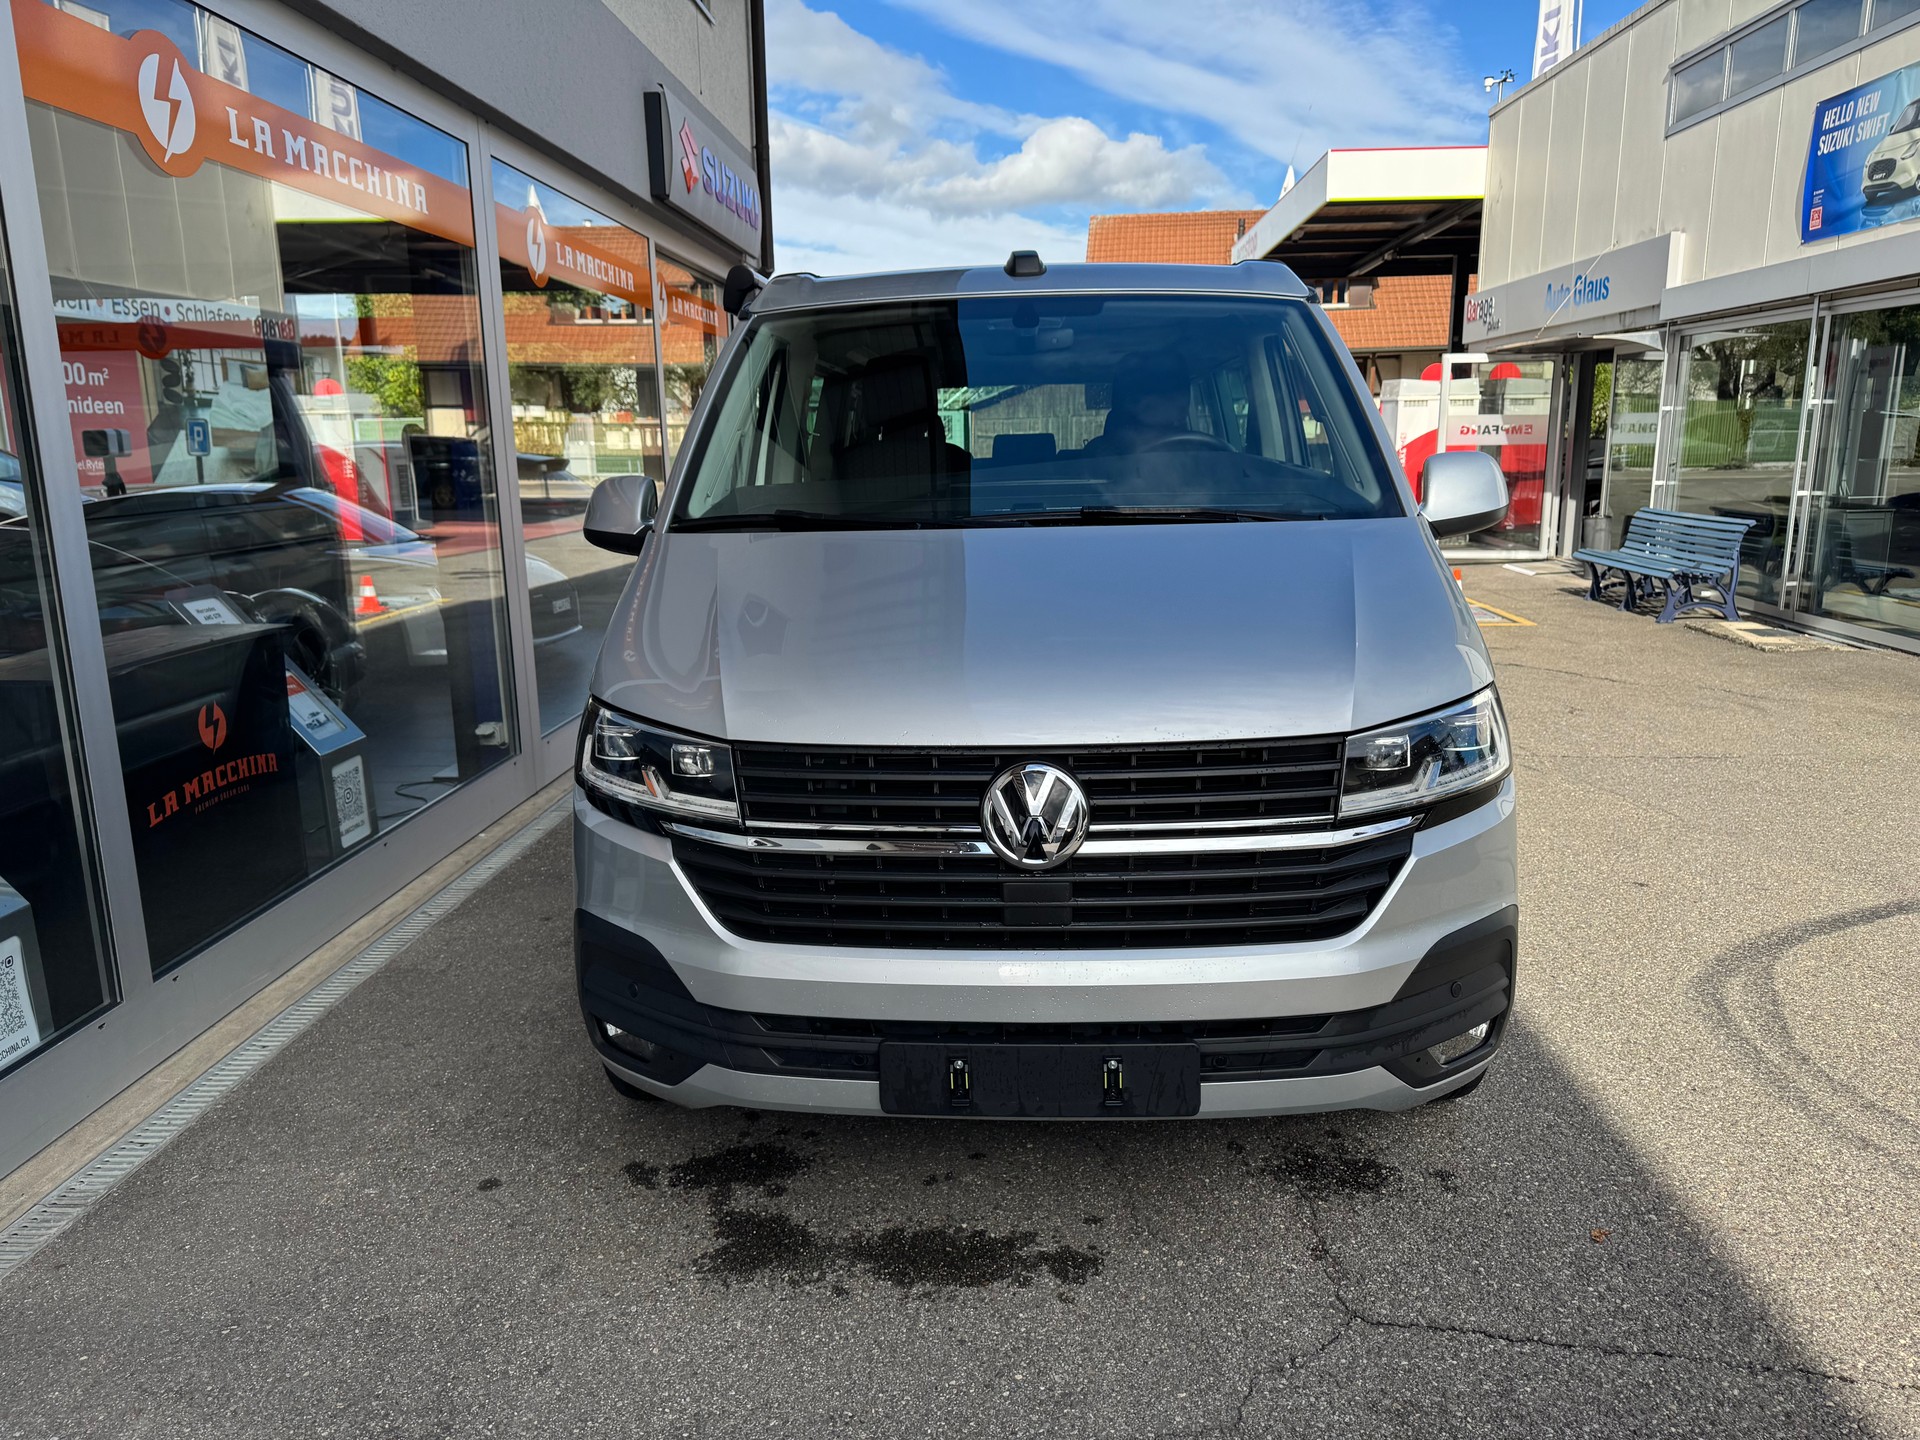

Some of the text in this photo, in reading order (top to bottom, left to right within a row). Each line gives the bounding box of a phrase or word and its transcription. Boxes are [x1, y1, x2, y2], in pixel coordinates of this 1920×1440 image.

[1822, 90, 1882, 131] HELLO NEW
[1817, 112, 1891, 156] SUZUKI SWIFT
[225, 106, 428, 215] LA MACCHINA
[702, 146, 759, 230] SUZUKI
[555, 242, 635, 292] LA MACCHINA
[111, 299, 160, 318] Essen
[672, 295, 683, 315] LA
[1467, 297, 1495, 324] Garage
[1544, 275, 1610, 313] Auto Glaus
[68, 396, 124, 414] nideen
[194, 427, 204, 450] P
[146, 752, 279, 828] LA MACCHINA
